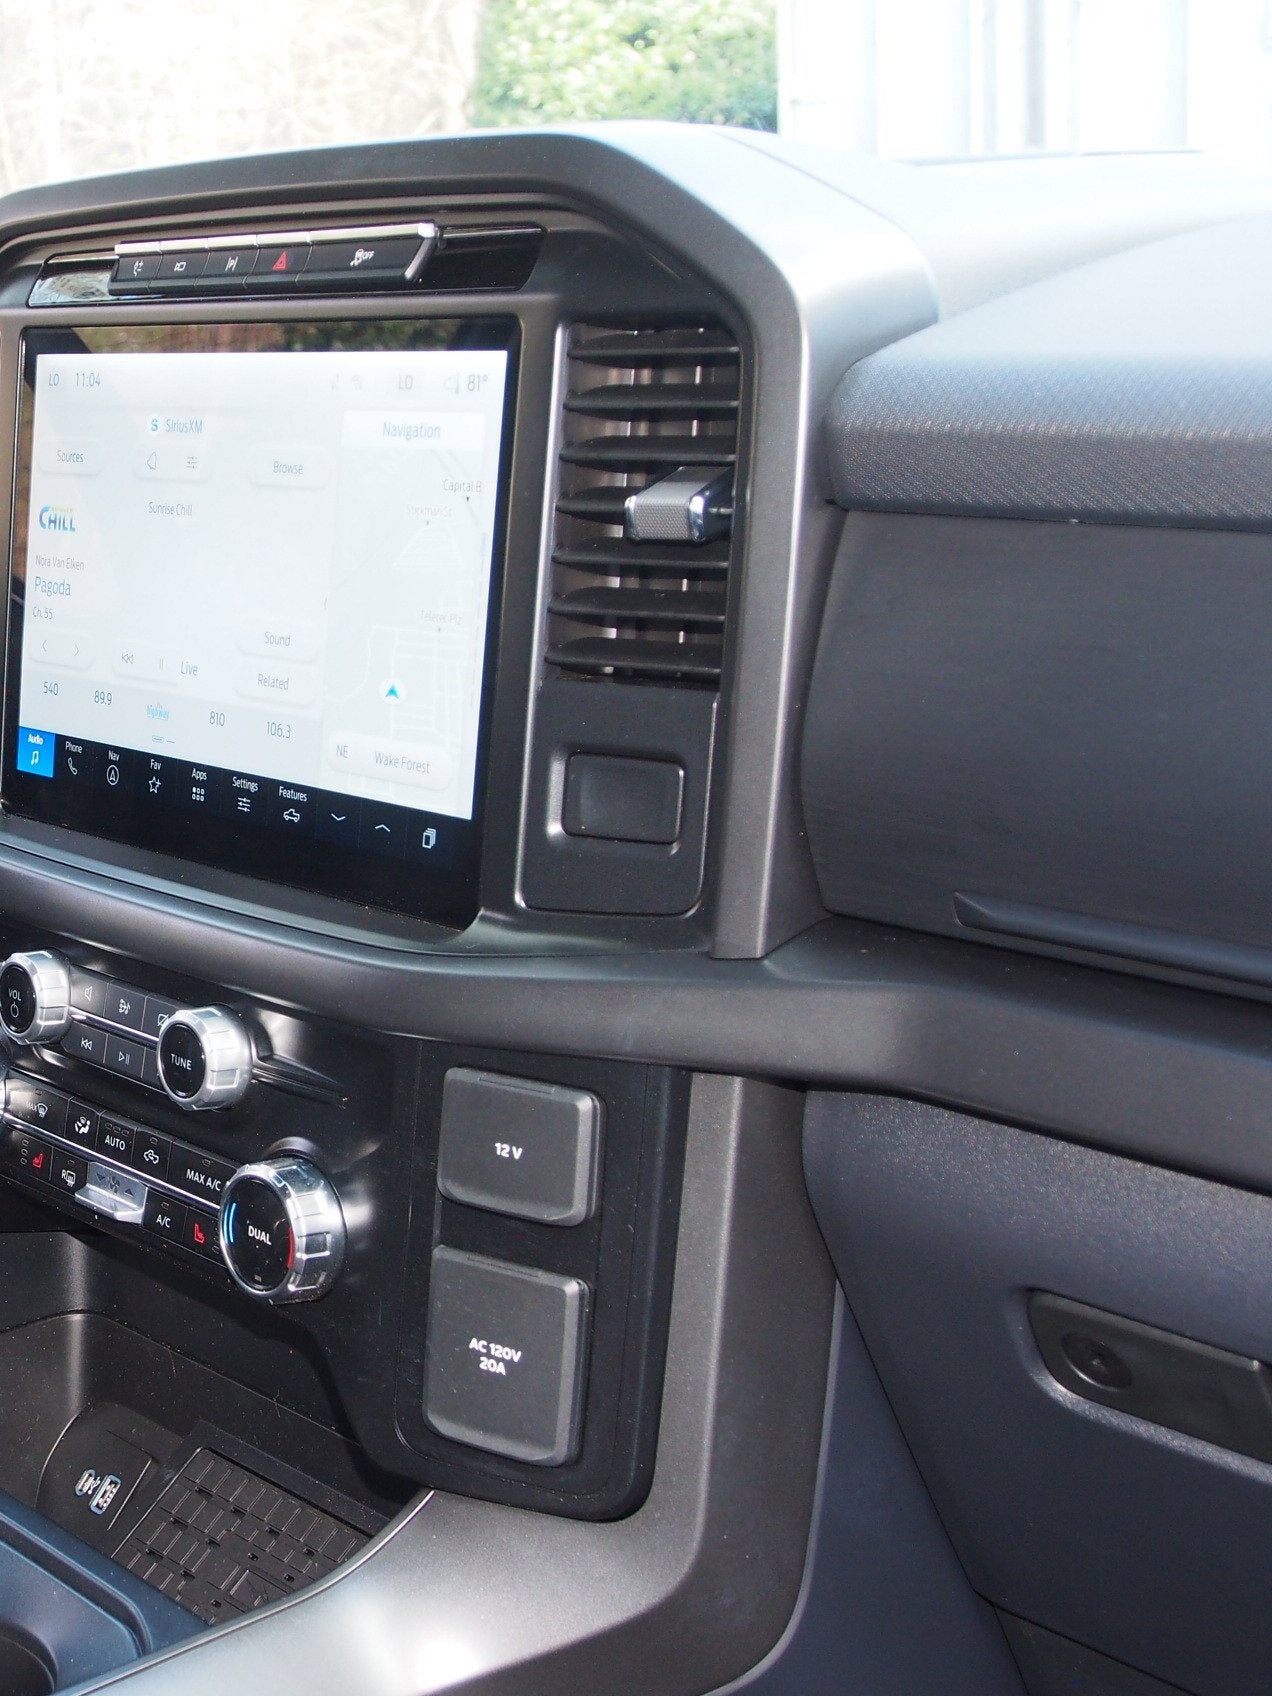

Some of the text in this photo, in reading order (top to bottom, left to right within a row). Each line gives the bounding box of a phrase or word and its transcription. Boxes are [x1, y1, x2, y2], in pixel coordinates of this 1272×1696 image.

[48, 372, 101, 388] LO 11:04
[397, 374, 414, 390] LO
[165, 418, 204, 434] SiriusXM
[382, 421, 441, 441] Navigation
[56, 449, 84, 464] Sources
[273, 460, 304, 475] Browse
[148, 501, 193, 516] Sunrise Chill
[38, 505, 76, 532] CHILL
[34, 576, 71, 597] Pagoda
[264, 631, 291, 647] Sound
[179, 661, 199, 677] Live
[43, 681, 59, 696] 540
[257, 673, 290, 690] Related
[93, 690, 113, 706] 89.9
[208, 711, 226, 727] 810
[266, 721, 292, 739] 106.3
[28, 733, 44, 746] Audio
[65, 741, 82, 754] Phone
[108, 750, 120, 762] Nav
[336, 745, 349, 759] NE
[150, 759, 161, 771] Fav
[374, 751, 431, 775] Wake Forest
[191, 768, 207, 781] Apps
[232, 776, 259, 792] Settings
[279, 786, 308, 802] Features
[7, 987, 22, 1002] VOL
[170, 1053, 193, 1071] TUNE
[104, 1134, 126, 1151] AUTO
[494, 1142, 523, 1160] 12 V
[186, 1168, 222, 1192] MAX A/C
[156, 1214, 171, 1228] A/C
[247, 1223, 272, 1247] DUAL
[469, 1336, 522, 1364] AC 120V
[478, 1355, 507, 1377] 20A
